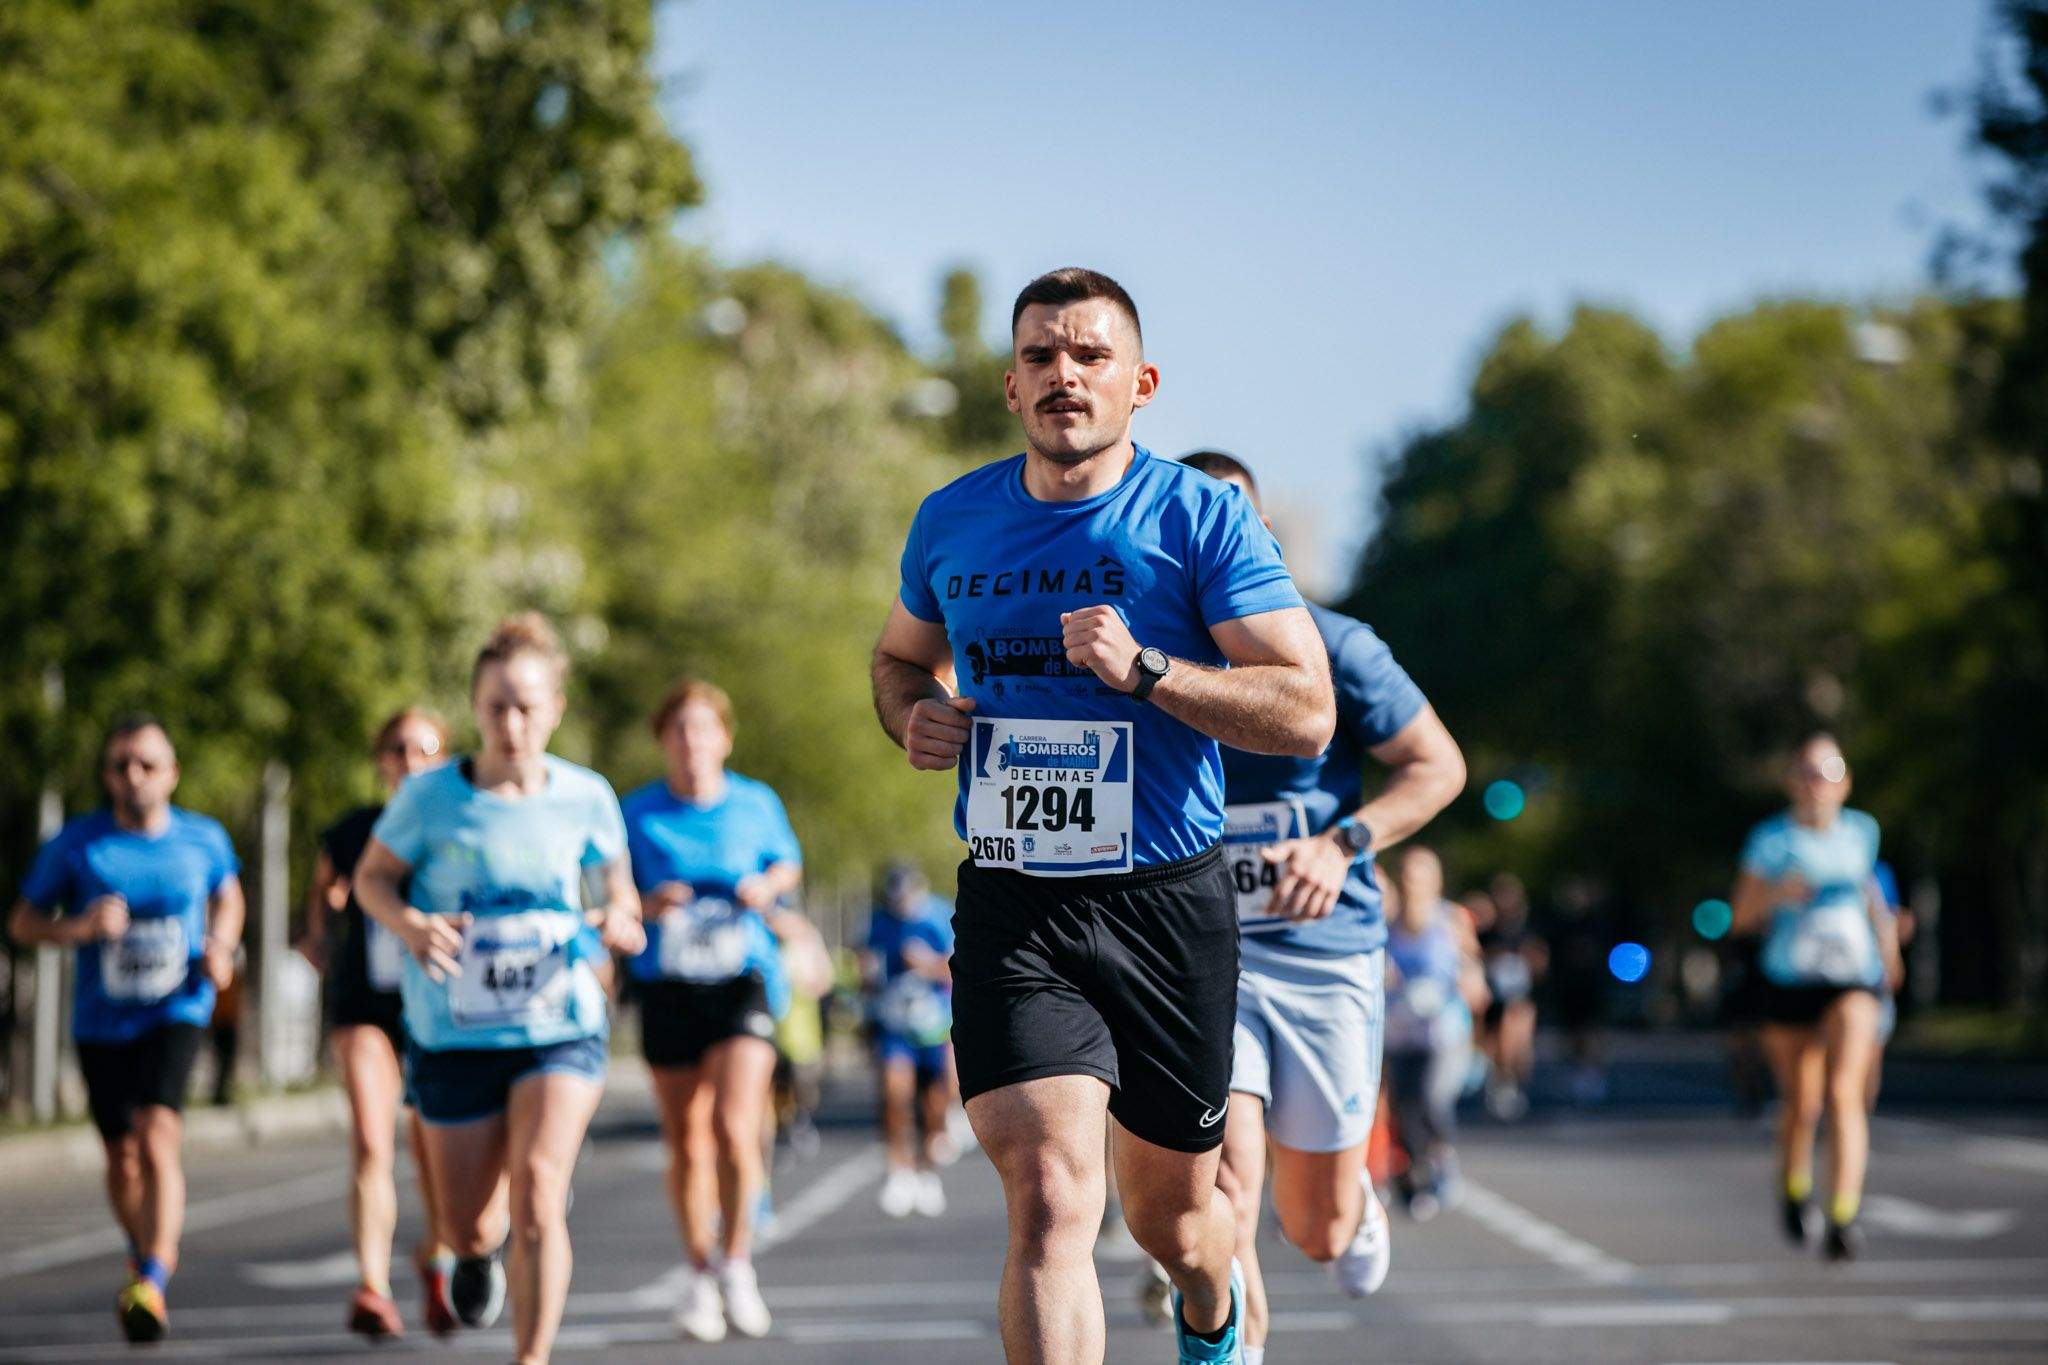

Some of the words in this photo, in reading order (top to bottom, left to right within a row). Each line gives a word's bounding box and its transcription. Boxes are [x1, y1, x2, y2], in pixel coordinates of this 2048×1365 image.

[947, 569, 1124, 600] DECIMAS
[994, 639, 1063, 657] BOMB
[1018, 743, 1097, 756] BOMBEROS
[1047, 756, 1059, 767] de
[1061, 756, 1097, 768] MADRID
[1011, 769, 1094, 782] DECIMAS
[1001, 785, 1096, 832] 1294
[971, 836, 1015, 862] 2676
[1235, 860, 1278, 894] 64
